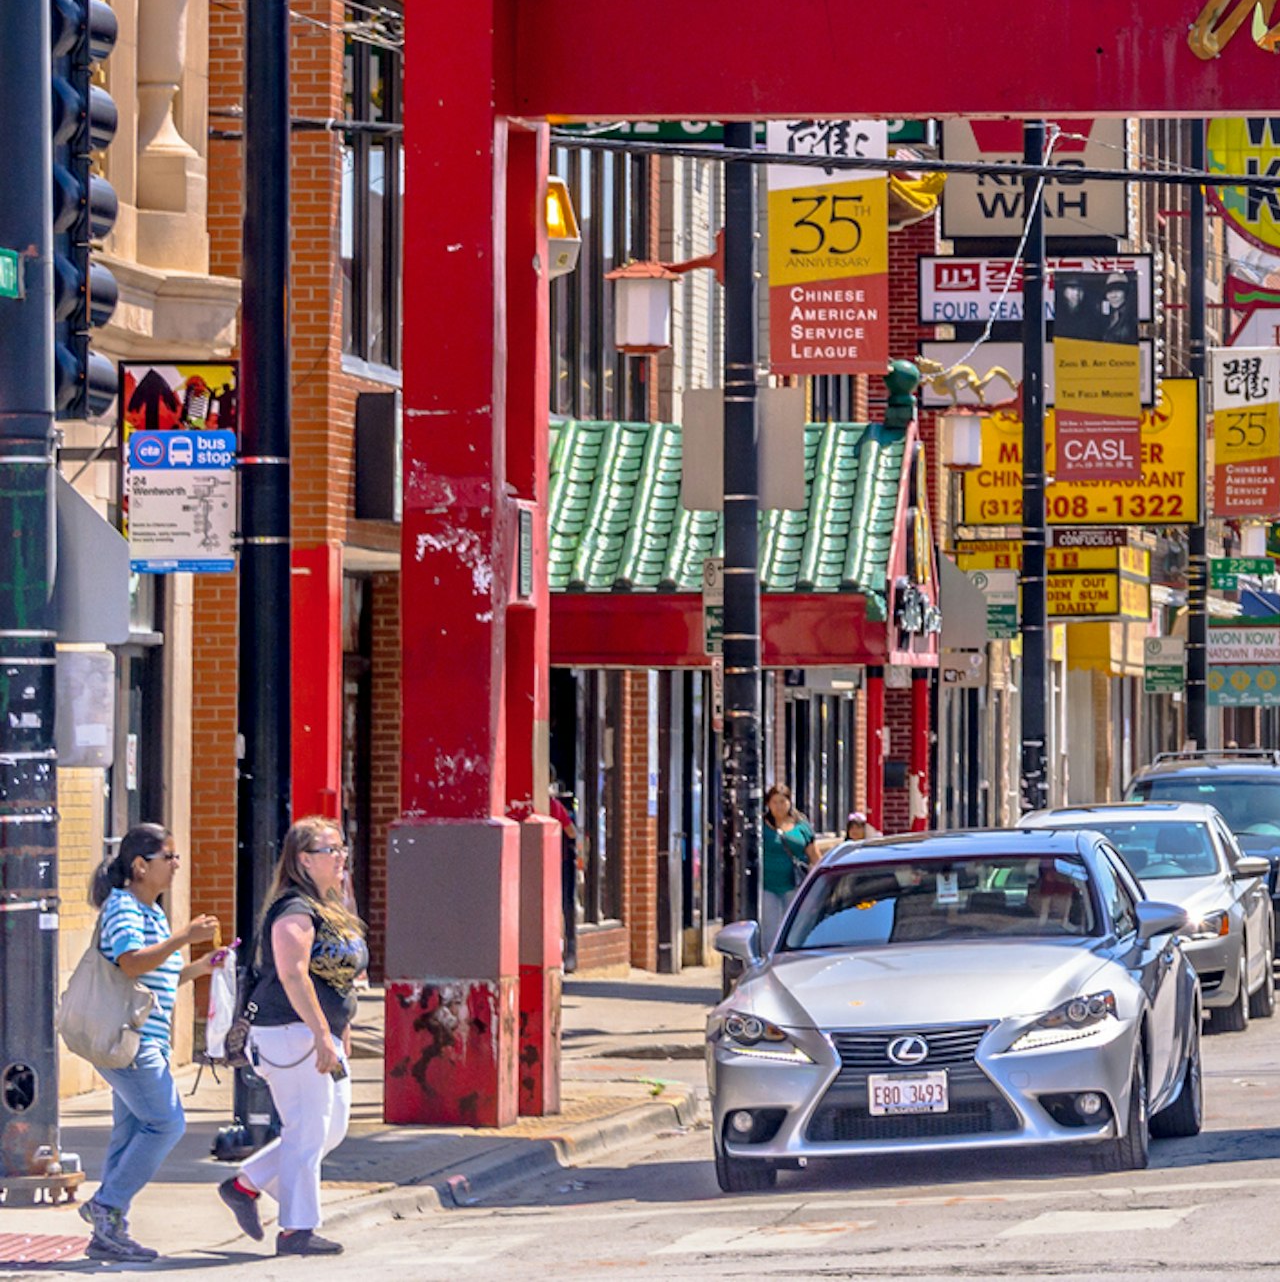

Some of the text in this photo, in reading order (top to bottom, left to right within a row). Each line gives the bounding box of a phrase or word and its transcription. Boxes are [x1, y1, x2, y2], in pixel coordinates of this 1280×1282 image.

[786, 256, 872, 269] ANNIVERSARY
[933, 301, 979, 319] FOUR
[1226, 411, 1268, 448] 35
[196, 435, 226, 450] bus
[1063, 439, 1134, 462] CASL
[196, 451, 232, 467] stop
[132, 476, 147, 486] 24
[132, 486, 187, 496] Wentworth
[1059, 534, 1113, 545] CONFUCIUS
[1082, 578, 1106, 588] OUT
[1079, 590, 1109, 600] SUM
[1056, 602, 1098, 613] DAILY
[1209, 632, 1275, 644] WON KOW
[874, 1084, 944, 1106] E80 3493
